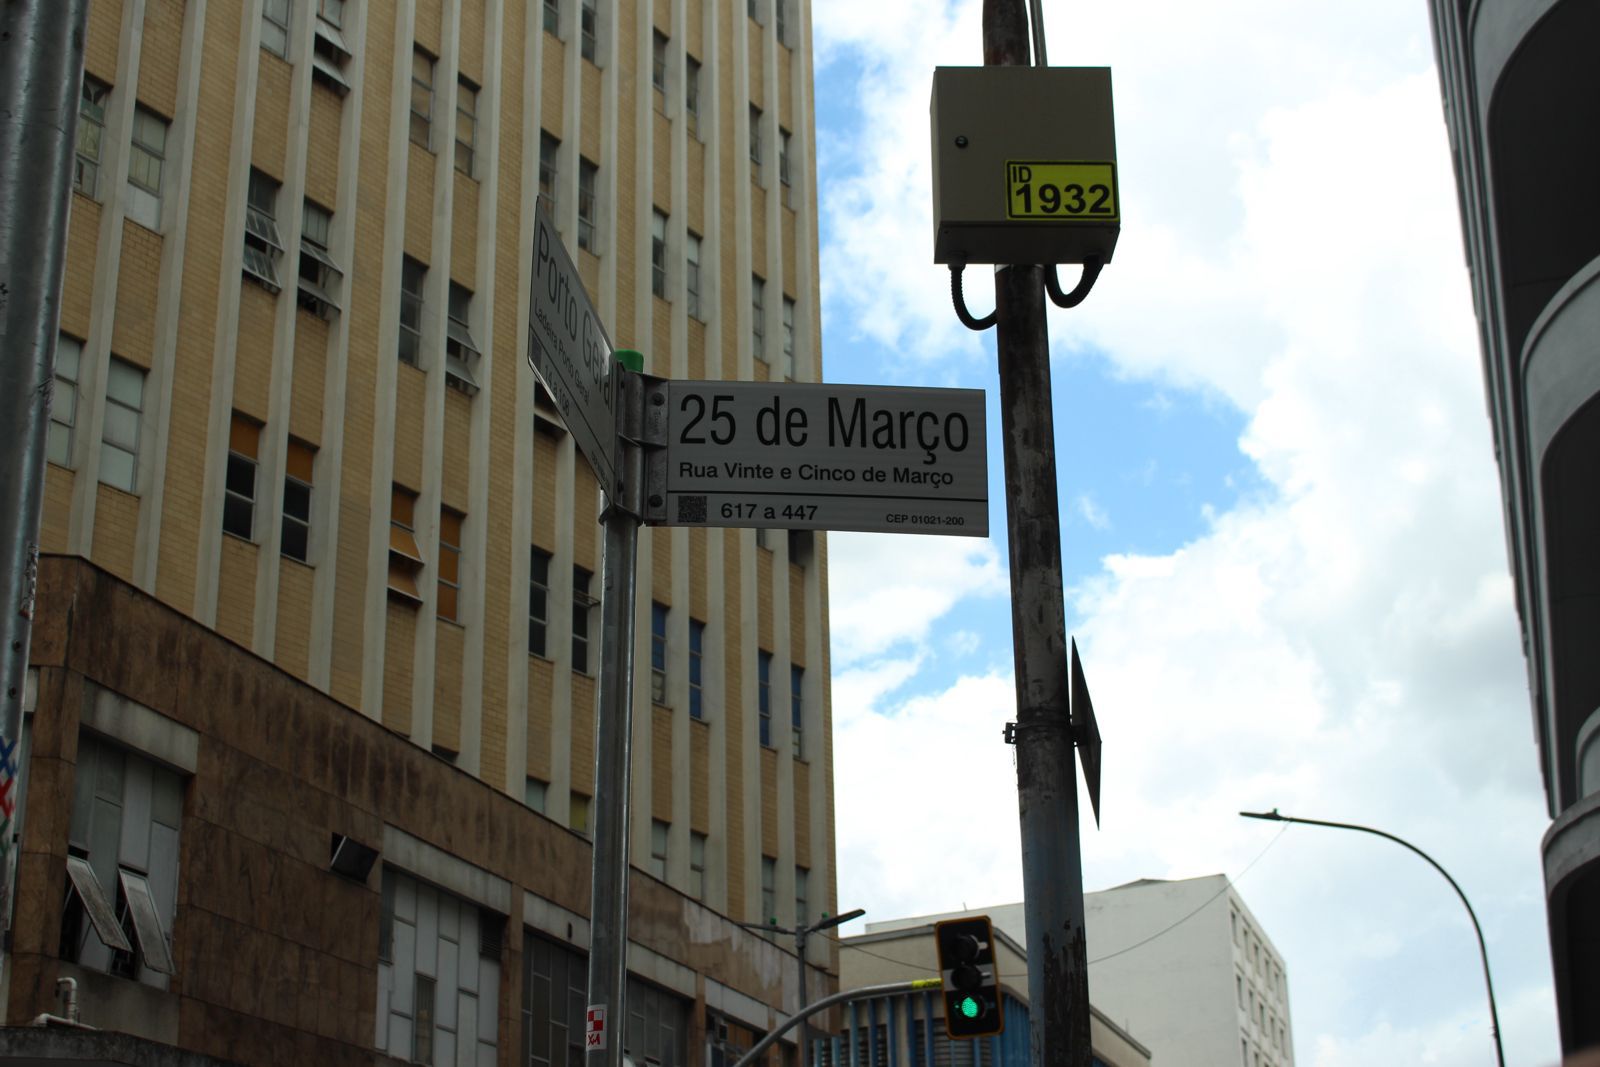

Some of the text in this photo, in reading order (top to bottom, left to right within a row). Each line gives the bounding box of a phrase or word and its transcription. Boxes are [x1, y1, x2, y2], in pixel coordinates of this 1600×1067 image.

[1012, 165, 1032, 184] ID
[1015, 183, 1112, 215] 1932
[537, 221, 578, 342] Porto
[582, 309, 613, 416] Geral
[534, 298, 590, 406] Ladeira Porto Geral
[680, 393, 737, 446] 25
[757, 395, 808, 447] de
[828, 397, 969, 466] Março
[679, 461, 954, 489] Rua Vinte e Cinco de Março
[720, 502, 818, 521] 617 a 447
[885, 513, 965, 526] CEP 01021-200
